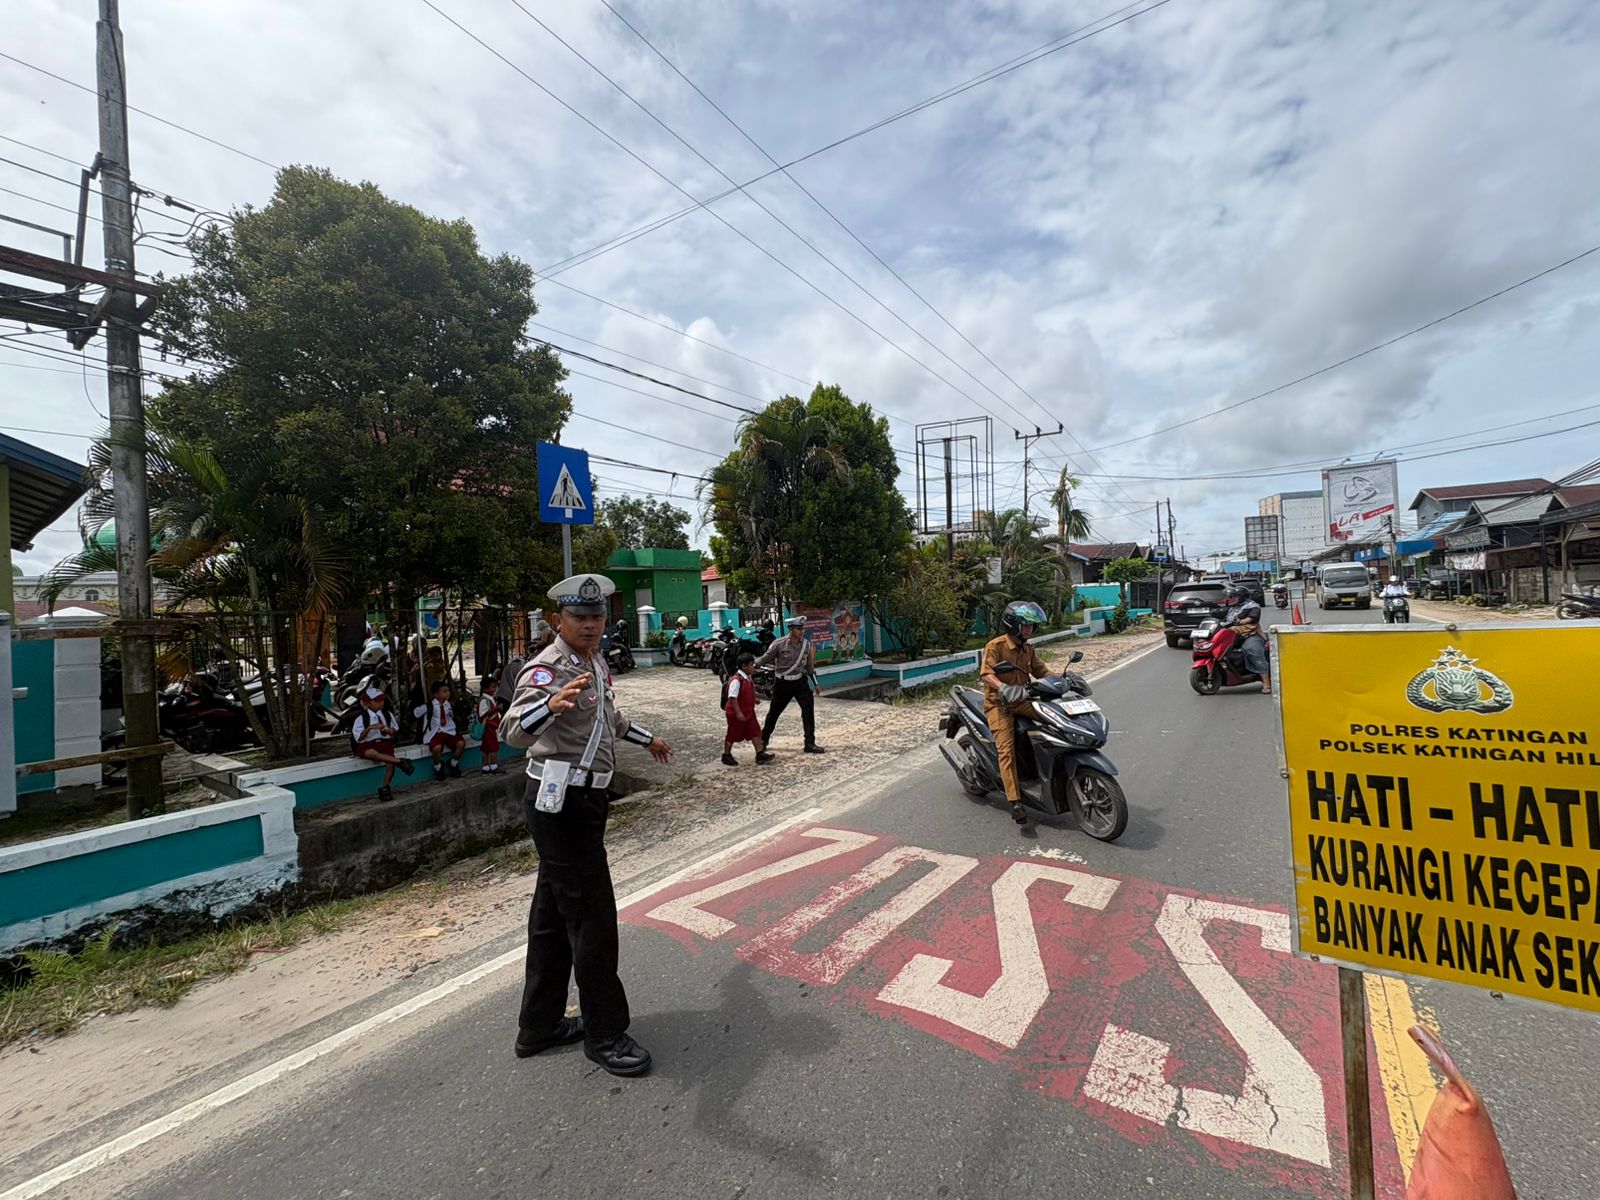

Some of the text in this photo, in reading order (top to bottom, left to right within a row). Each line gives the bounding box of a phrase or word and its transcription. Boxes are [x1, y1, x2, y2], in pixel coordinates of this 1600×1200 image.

[1320, 739, 1408, 755] POLSEK
[1414, 744, 1545, 763] KATINGAN
[1350, 724, 1587, 745] POLRES KATINGAN
[1307, 770, 1413, 830] HATI
[1469, 782, 1600, 850] HATI
[1308, 834, 1600, 925] KURANGI KECEP
[1313, 896, 1600, 998] BANYAK ANAK SEK
